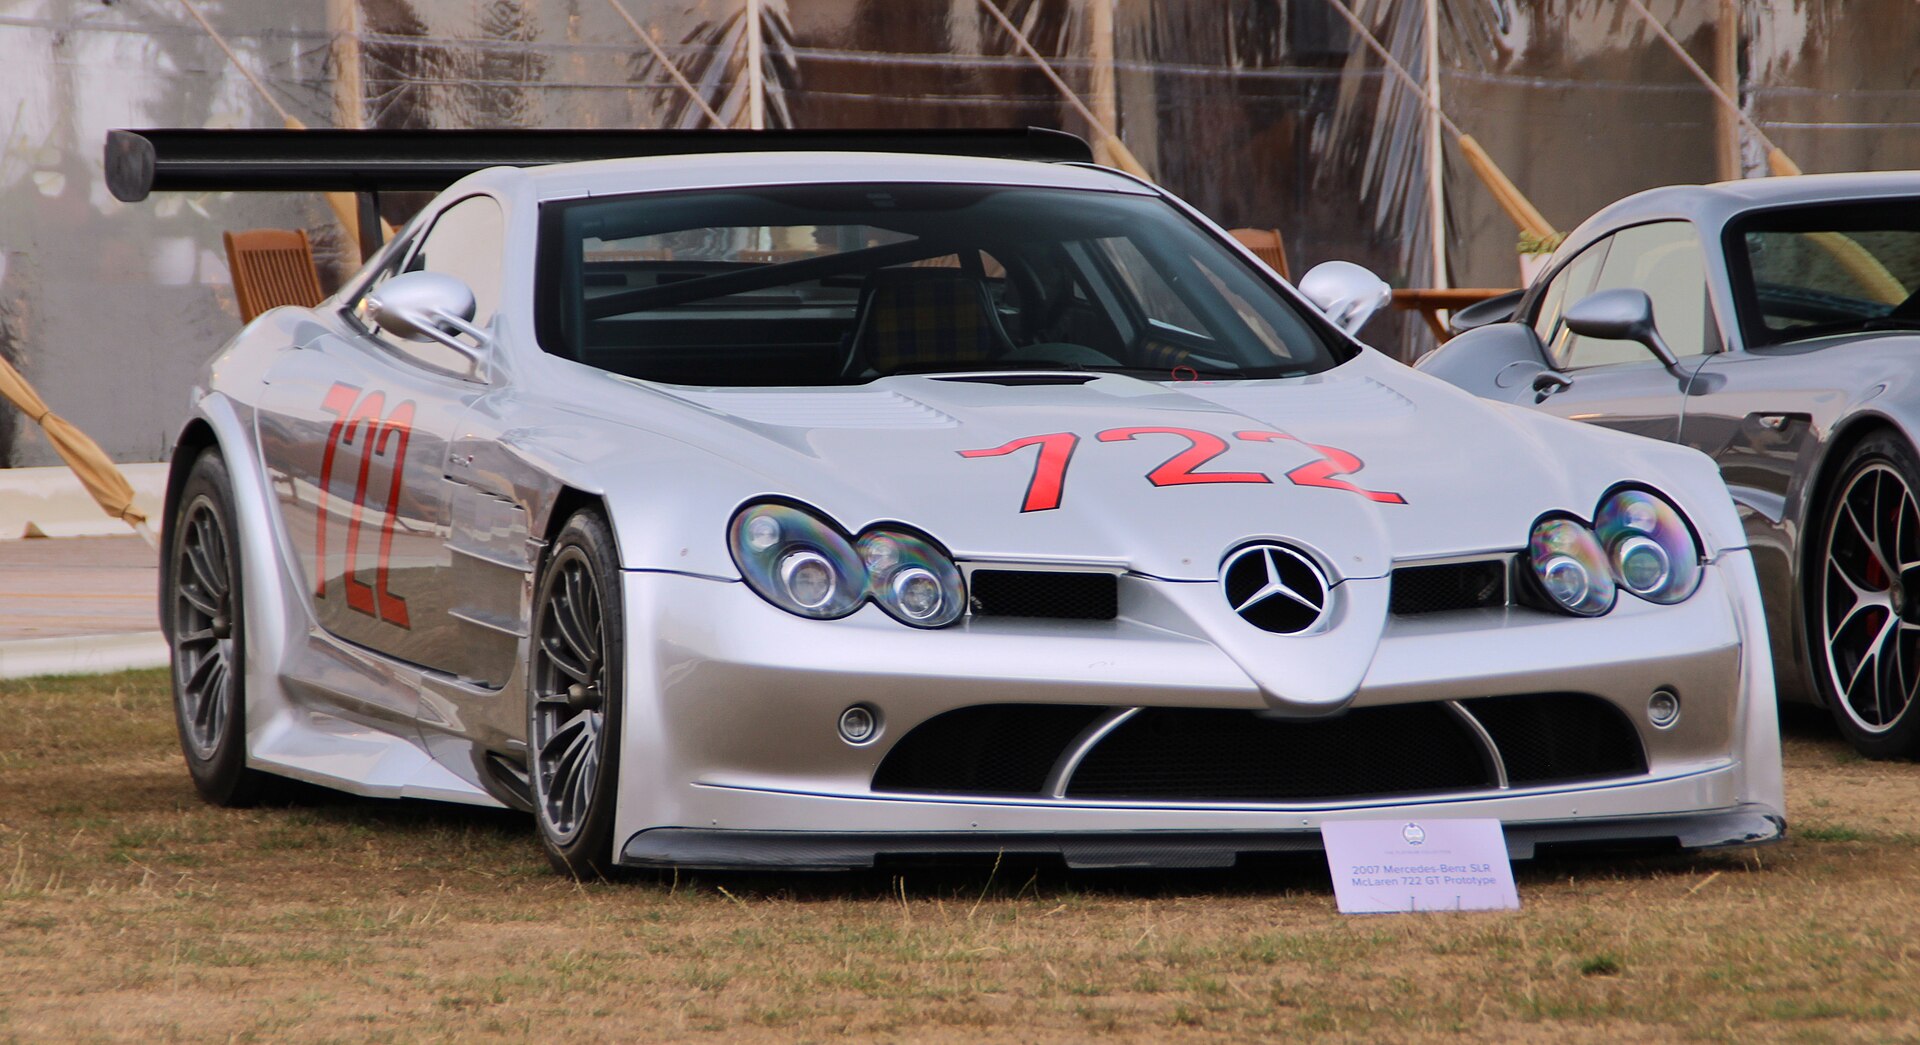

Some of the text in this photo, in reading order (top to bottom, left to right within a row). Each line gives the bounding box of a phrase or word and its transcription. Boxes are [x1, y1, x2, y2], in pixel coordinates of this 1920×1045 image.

[956, 427, 1409, 513] 722
[314, 379, 412, 631] 722
[1352, 863, 1491, 875] 2007 Mercedes-Benz SLR
[1352, 875, 1497, 887] McLaren 722 GT Prototype
